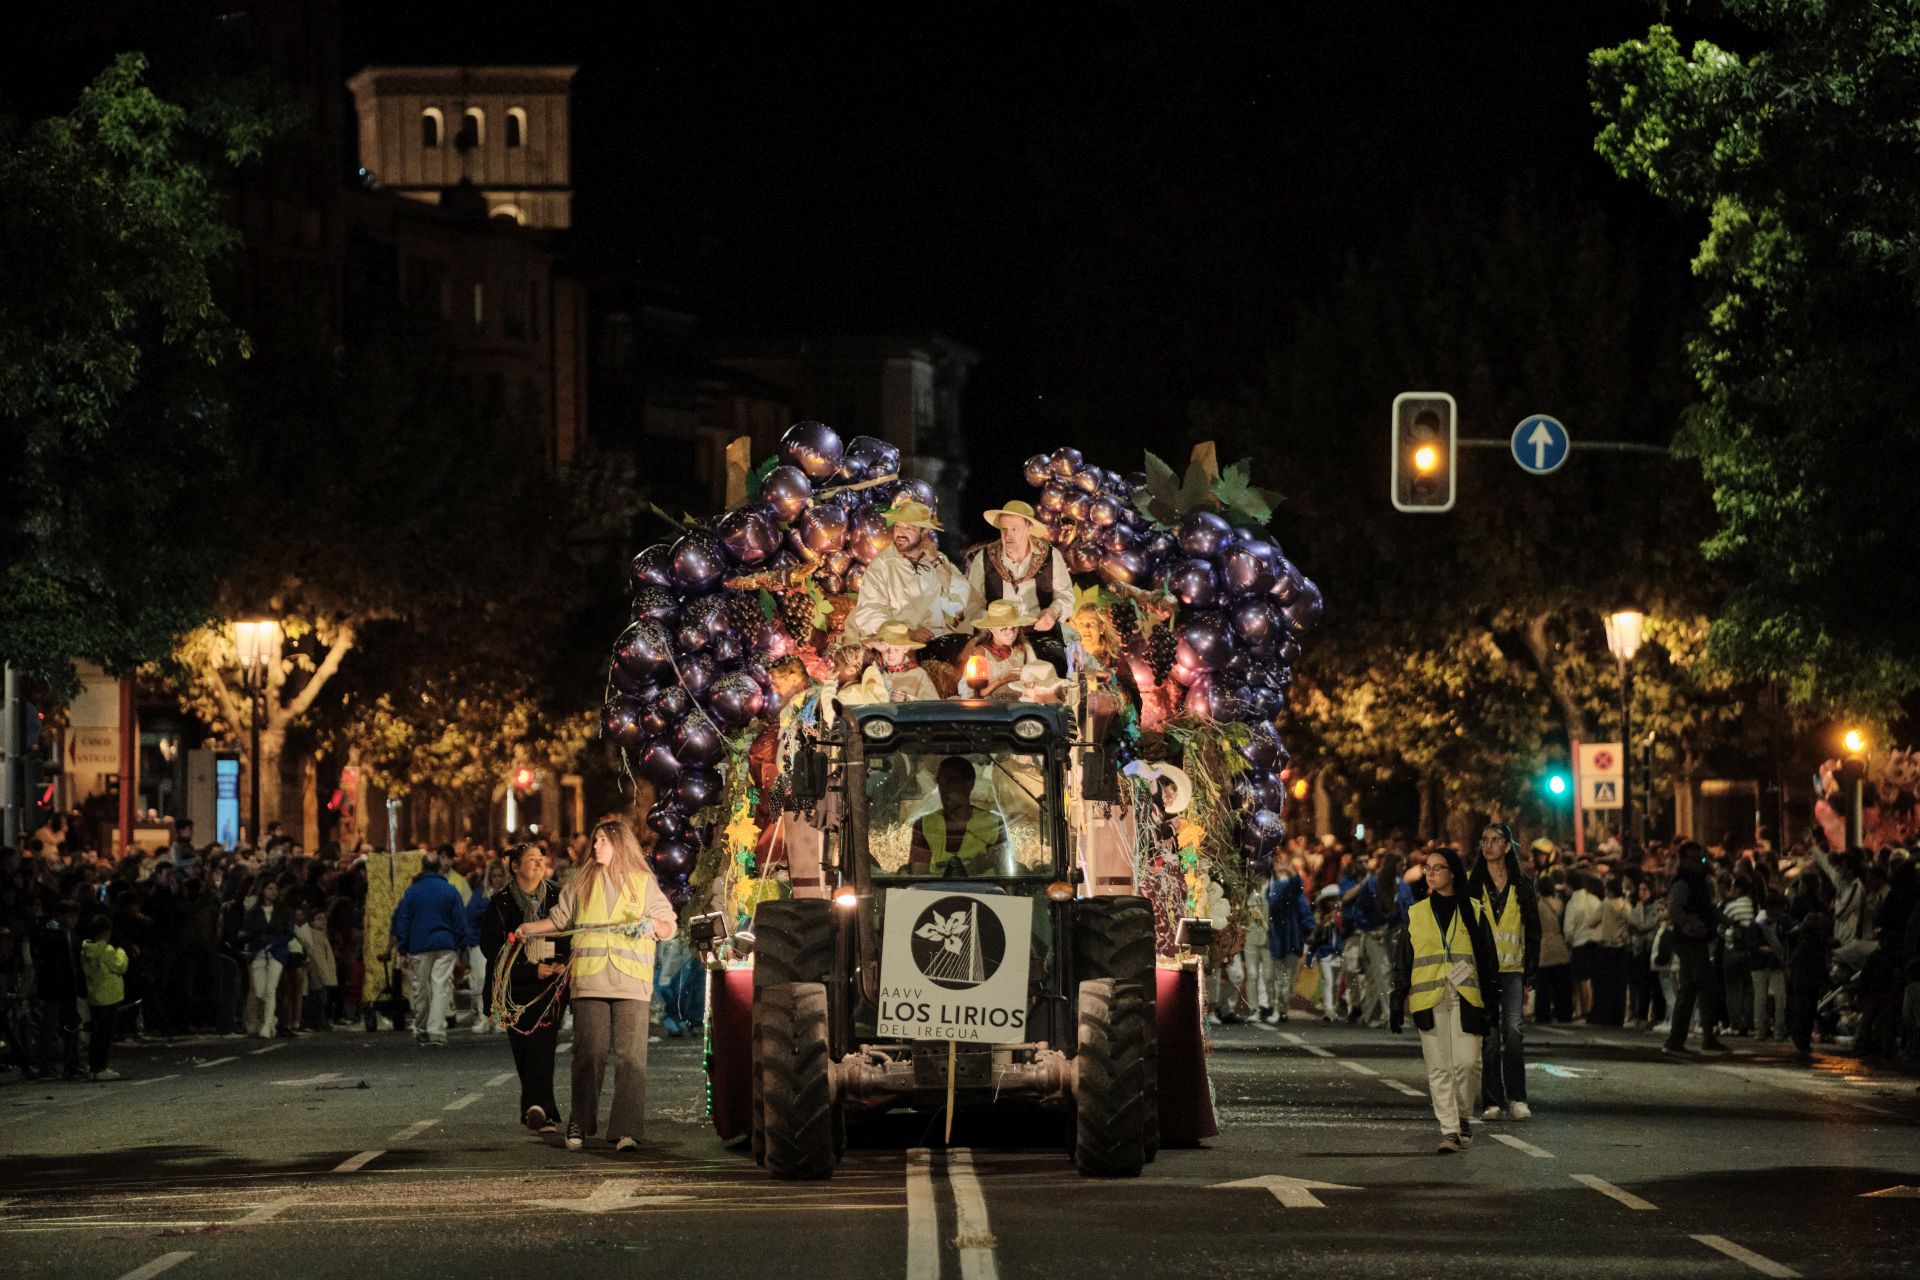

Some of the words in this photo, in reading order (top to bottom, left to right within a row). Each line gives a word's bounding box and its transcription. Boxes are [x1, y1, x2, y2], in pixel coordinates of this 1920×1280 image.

[880, 986, 923, 999] AAVV
[881, 1001, 931, 1022] LOS
[941, 1004, 1025, 1028] LIRIOS
[879, 1023, 909, 1036] DEL
[917, 1026, 979, 1040] IREGUA
